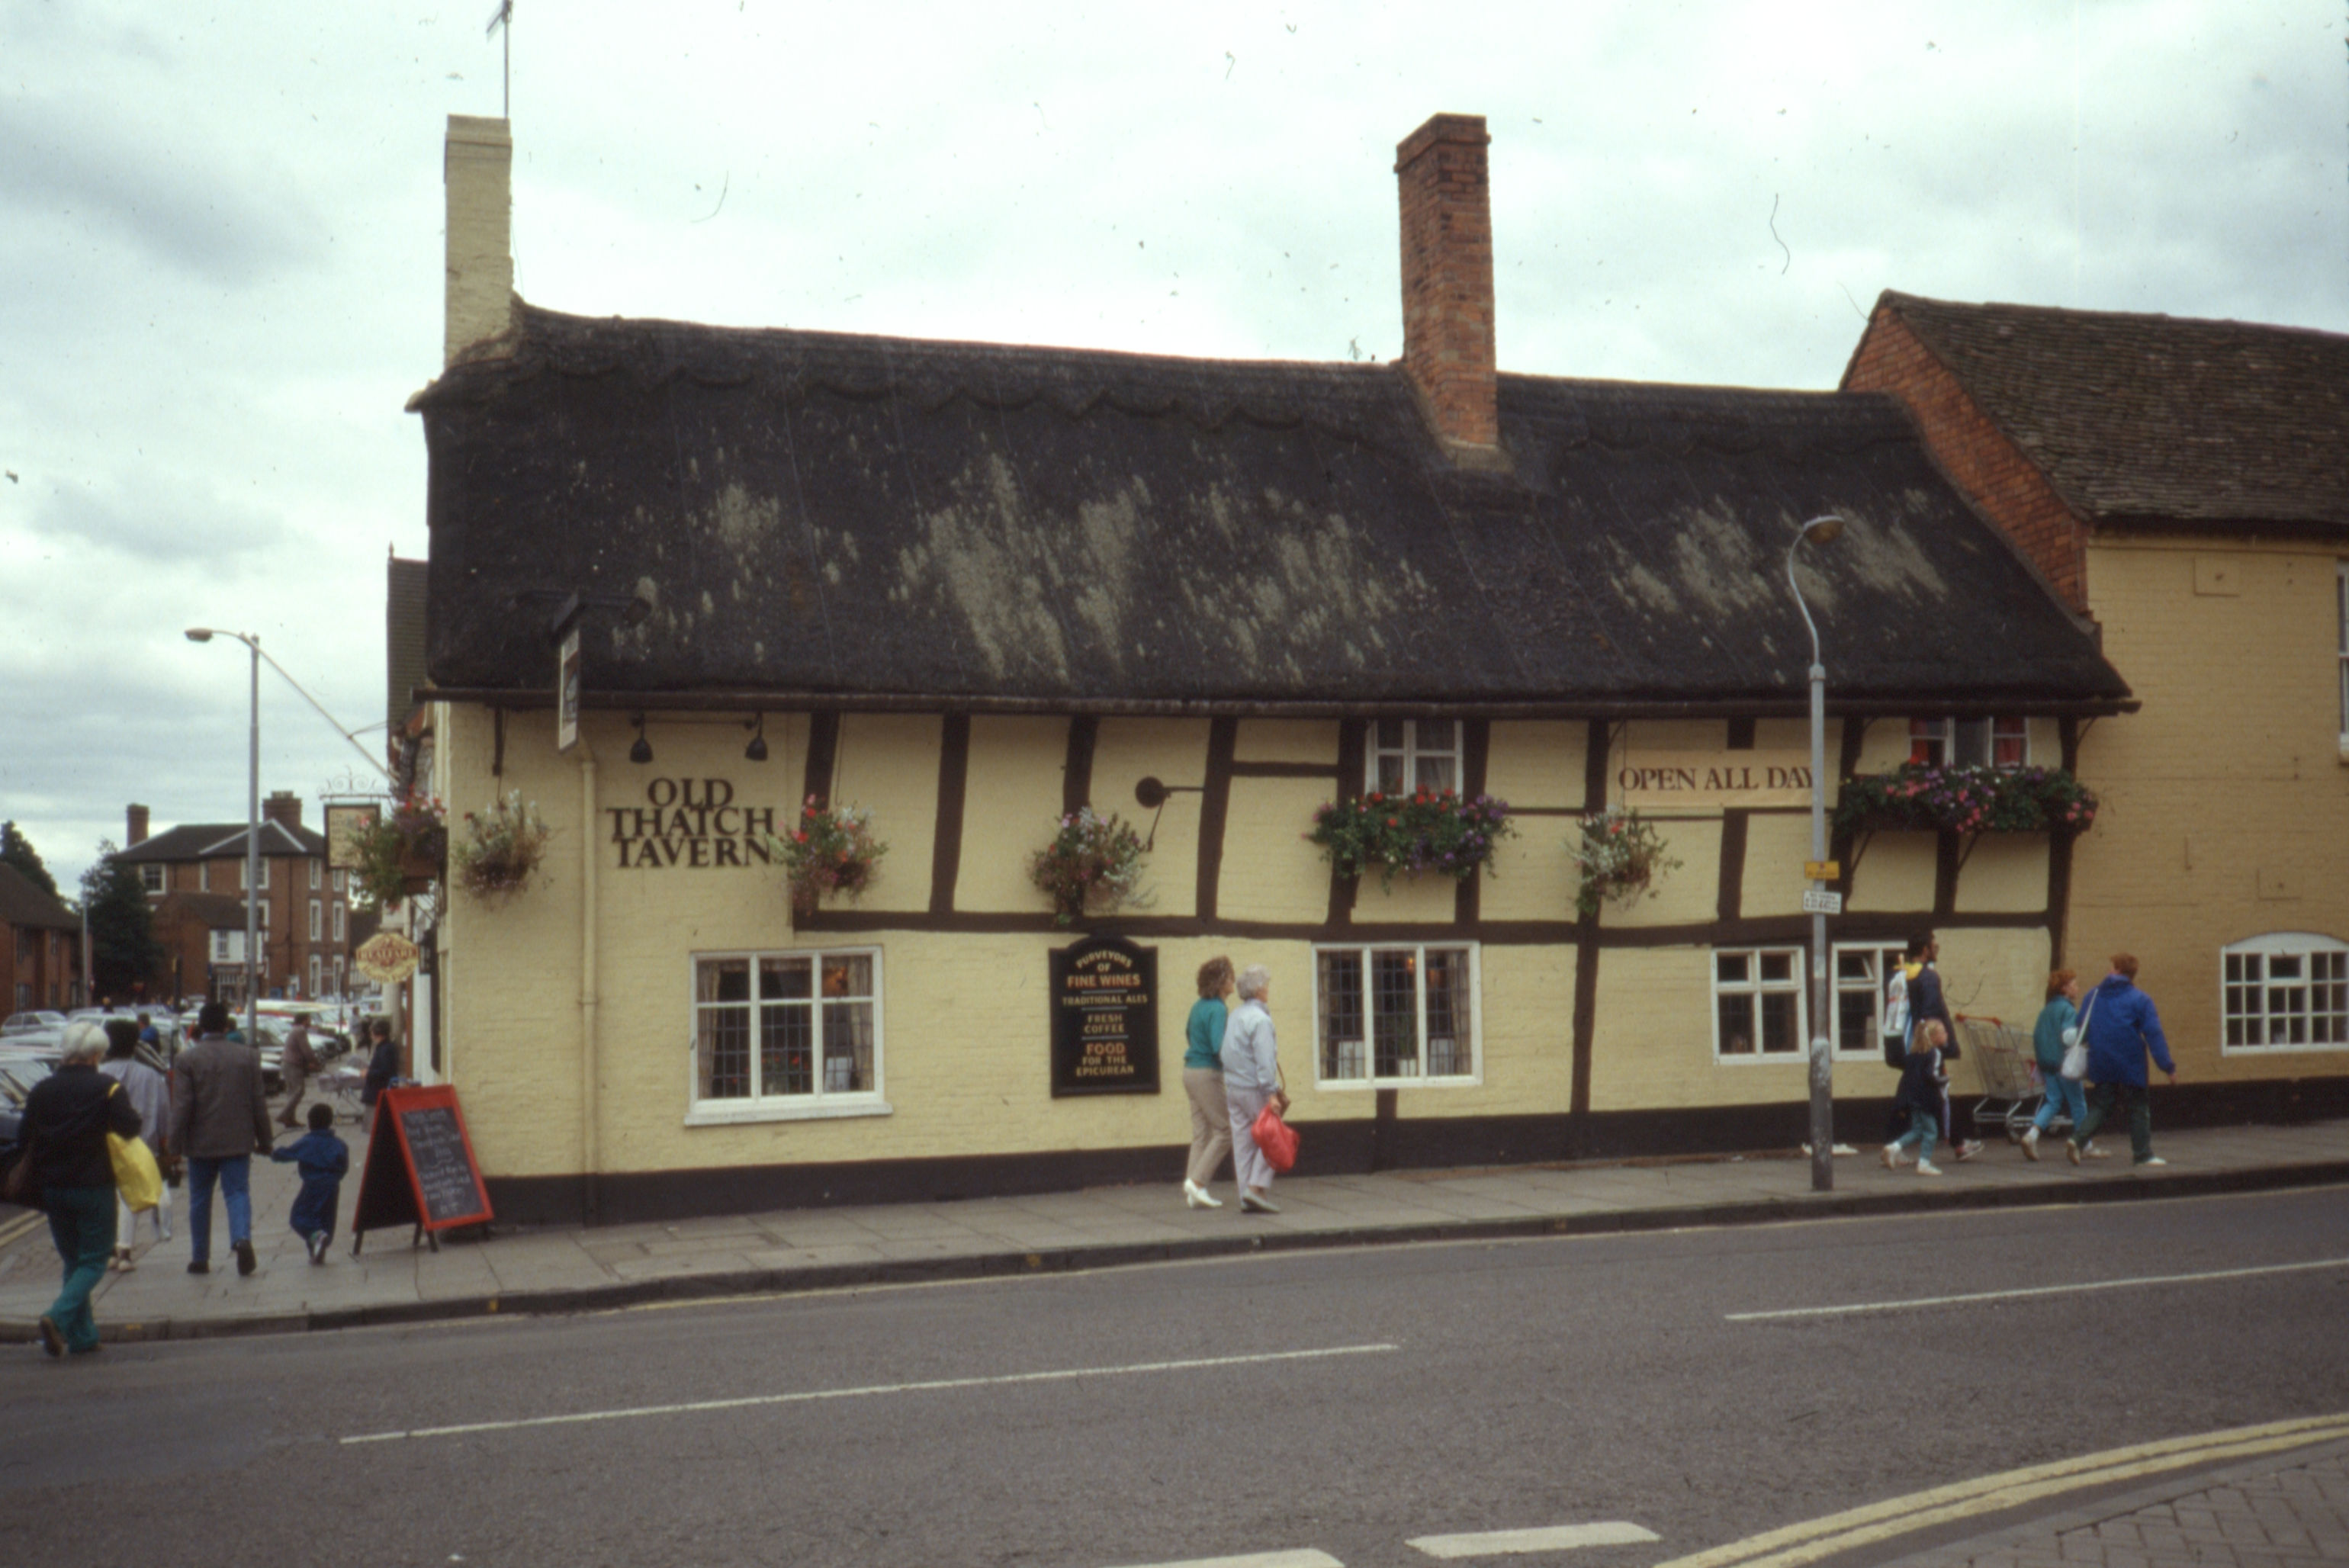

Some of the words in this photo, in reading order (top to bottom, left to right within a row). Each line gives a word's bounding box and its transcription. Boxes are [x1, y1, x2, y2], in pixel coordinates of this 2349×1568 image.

[1618, 768, 1697, 791] OPEN
[1704, 767, 1759, 790] ALL
[647, 777, 734, 808] OLD
[606, 807, 773, 837] THATCH
[612, 838, 770, 867] TAVERN
[1075, 950, 1133, 969] PURVEYORS
[1097, 962, 1111, 972] OF
[1067, 975, 1096, 988] FINE
[1101, 974, 1141, 988] WINES
[1062, 995, 1122, 1006] TRADITIONAL
[1126, 994, 1147, 1004] ALES
[1088, 1014, 1123, 1023] FRESH
[1085, 1023, 1124, 1034] COFFEE
[1086, 1043, 1126, 1056] FOOD
[1083, 1056, 1101, 1065] FOR
[1107, 1056, 1126, 1064] THE
[1076, 1065, 1134, 1077] EPICUREAN
